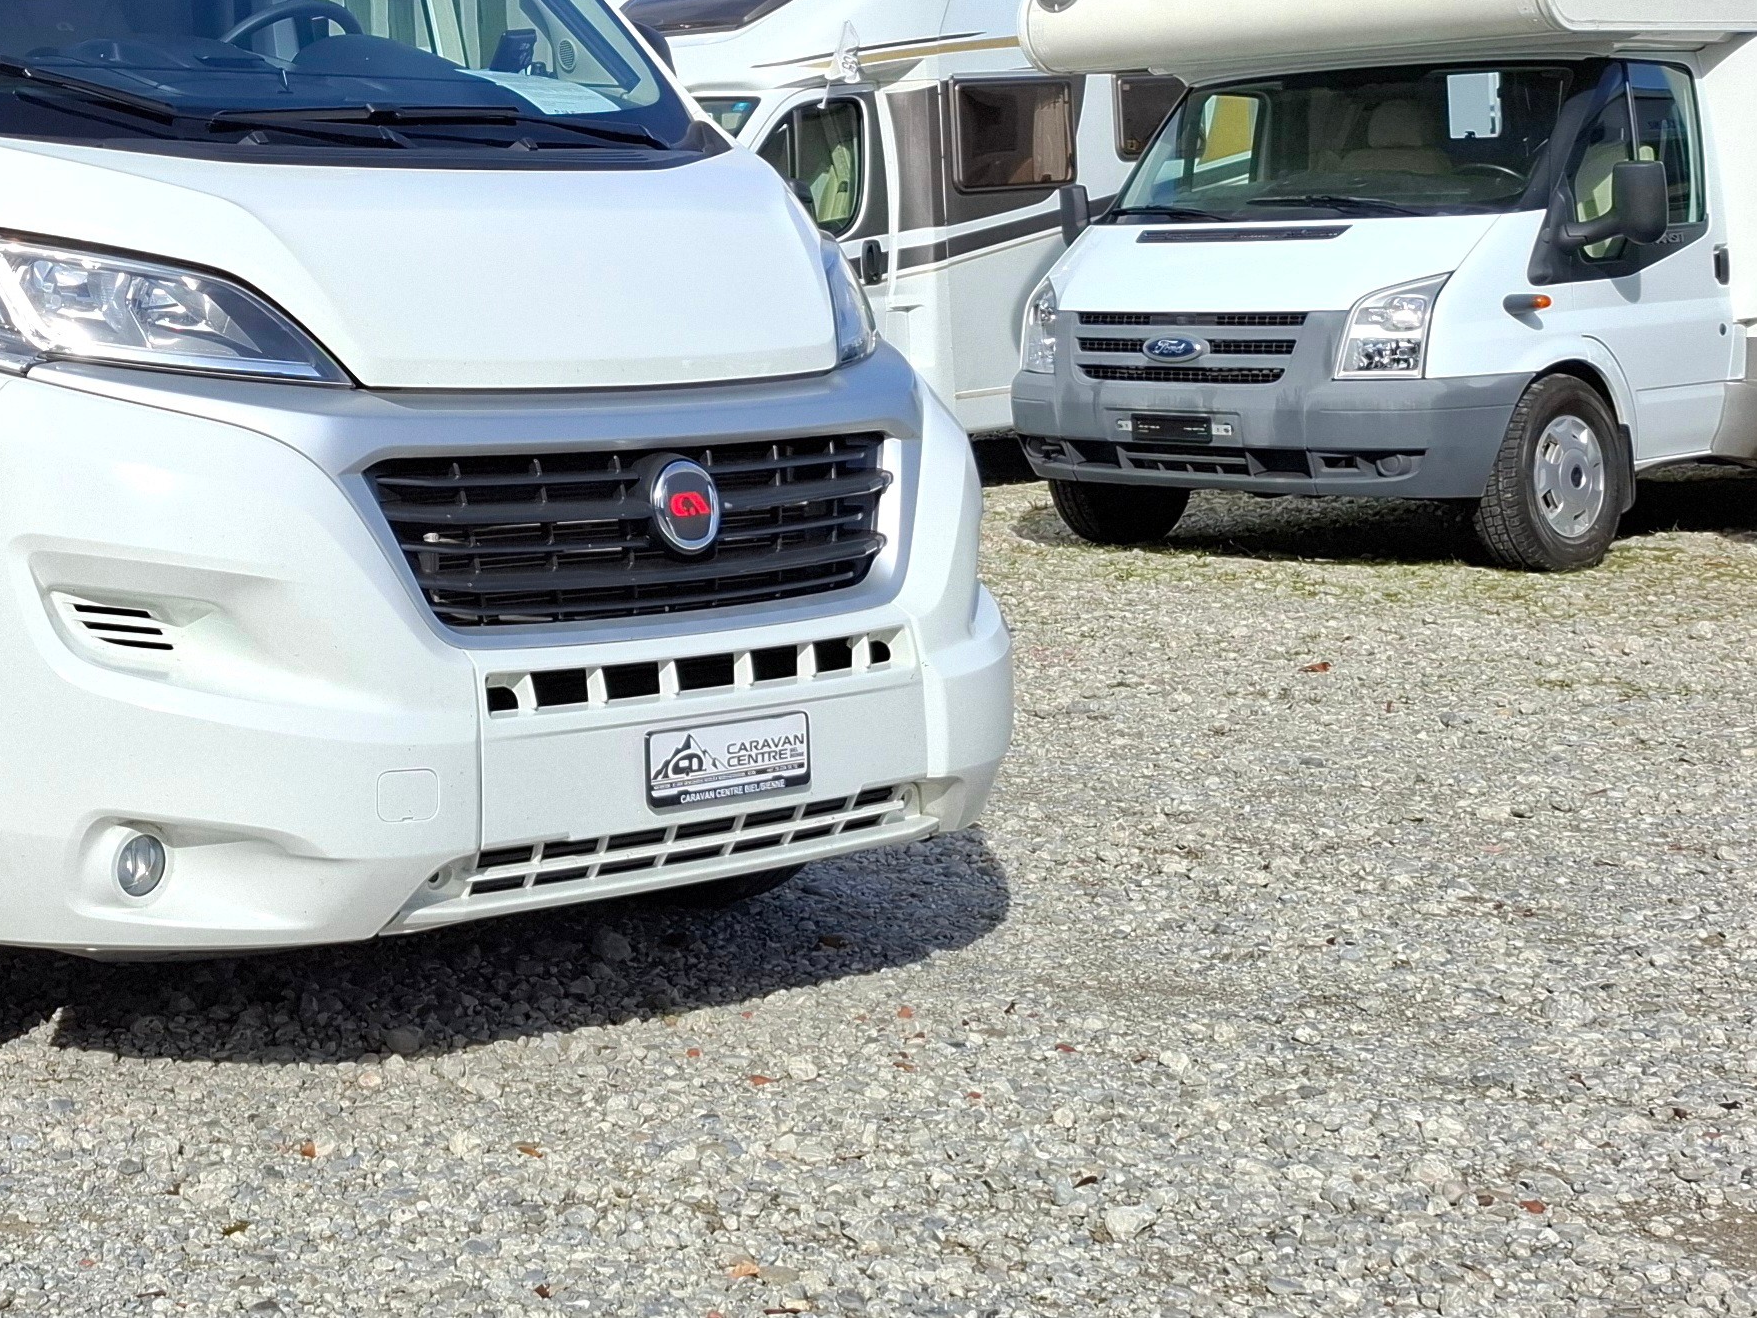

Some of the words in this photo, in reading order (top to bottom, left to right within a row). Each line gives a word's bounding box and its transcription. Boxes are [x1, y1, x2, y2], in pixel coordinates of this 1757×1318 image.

[1152, 339, 1186, 354] Ford
[726, 733, 805, 755] CARAVAN
[727, 748, 789, 768] CENTRE
[680, 790, 715, 804] CARAVAN
[715, 785, 744, 798] CENTRE
